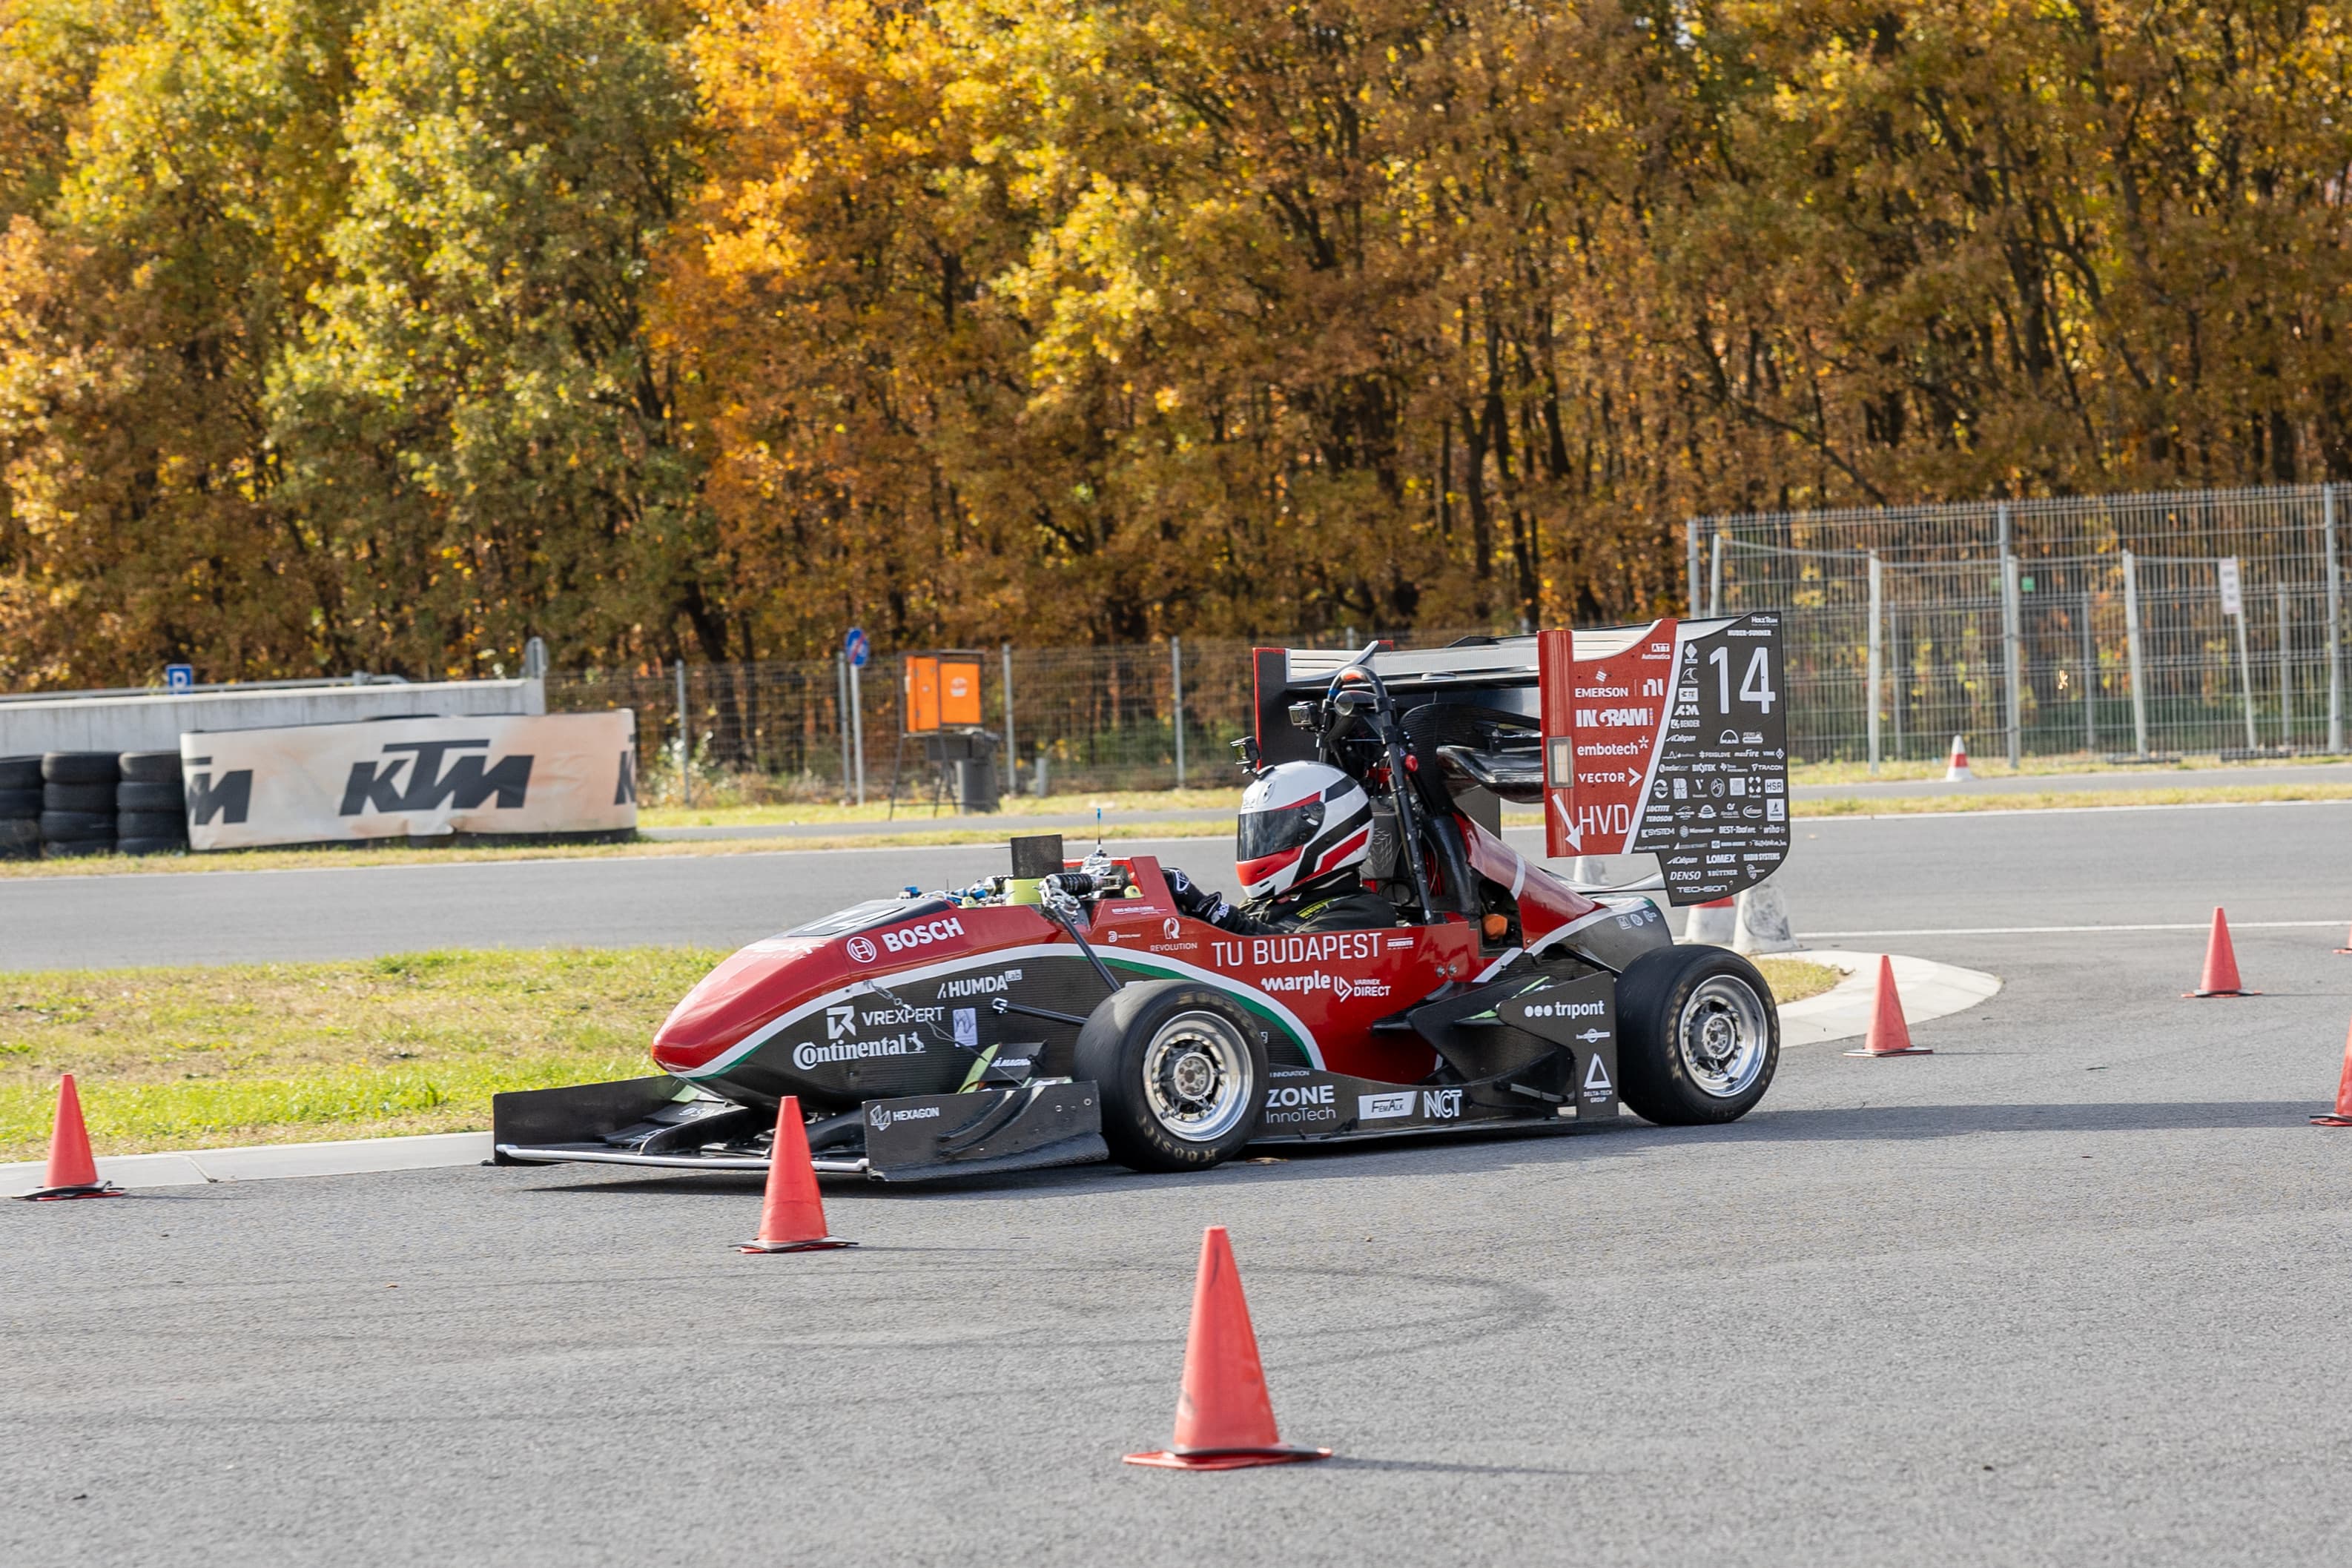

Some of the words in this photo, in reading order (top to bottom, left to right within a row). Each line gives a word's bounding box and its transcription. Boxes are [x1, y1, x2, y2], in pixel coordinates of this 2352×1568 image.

[1652, 644, 1670, 652] ATT
[173, 672, 187, 695] P
[1709, 646, 1777, 714] 14
[1574, 687, 1628, 698] EMERSON
[1576, 709, 1648, 727] INGRAM
[1577, 742, 1638, 756] embotech
[339, 739, 535, 816] KTM
[1578, 773, 1625, 783] VECTOR
[1766, 781, 1783, 790] HSR
[1578, 804, 1630, 836] HVD
[1706, 853, 1737, 864] LOMEX
[1670, 870, 1702, 881] DENSO
[882, 917, 965, 953] BOSCH
[1150, 942, 1198, 952] REVOLUTION
[1211, 941, 1243, 967] TU
[1253, 933, 1382, 965] BUDAPEST
[948, 975, 1008, 998] HUMDA
[1006, 972, 1021, 980] Lab
[1261, 970, 1331, 995] marple
[1353, 985, 1391, 996] DIRECT
[862, 1006, 945, 1026] VREXPERT
[1554, 1000, 1605, 1019] tripont
[793, 1034, 907, 1071] Continental
[1265, 1085, 1335, 1108] ZONE
[1423, 1089, 1462, 1118] NCT
[892, 1107, 939, 1121] HEXAGON
[1265, 1106, 1336, 1124] InnoTech
